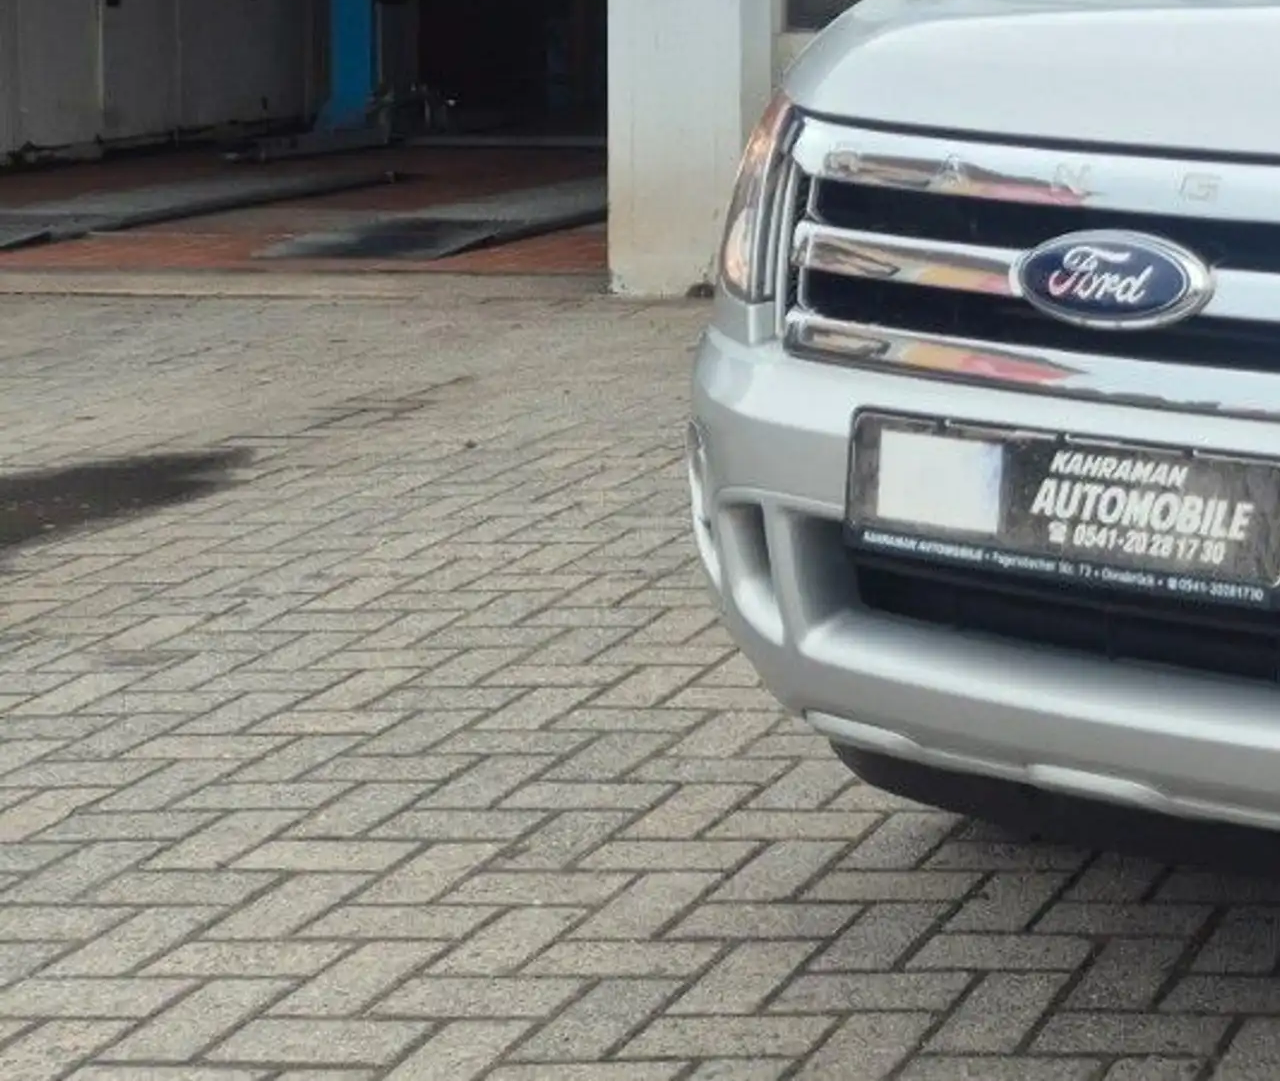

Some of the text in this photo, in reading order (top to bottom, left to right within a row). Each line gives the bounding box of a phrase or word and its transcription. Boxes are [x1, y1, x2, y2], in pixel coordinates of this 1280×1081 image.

[1049, 246, 1153, 304] Ford
[1050, 450, 1190, 488] KAHRAMAN
[1030, 477, 1255, 541] AUTOMOBILE
